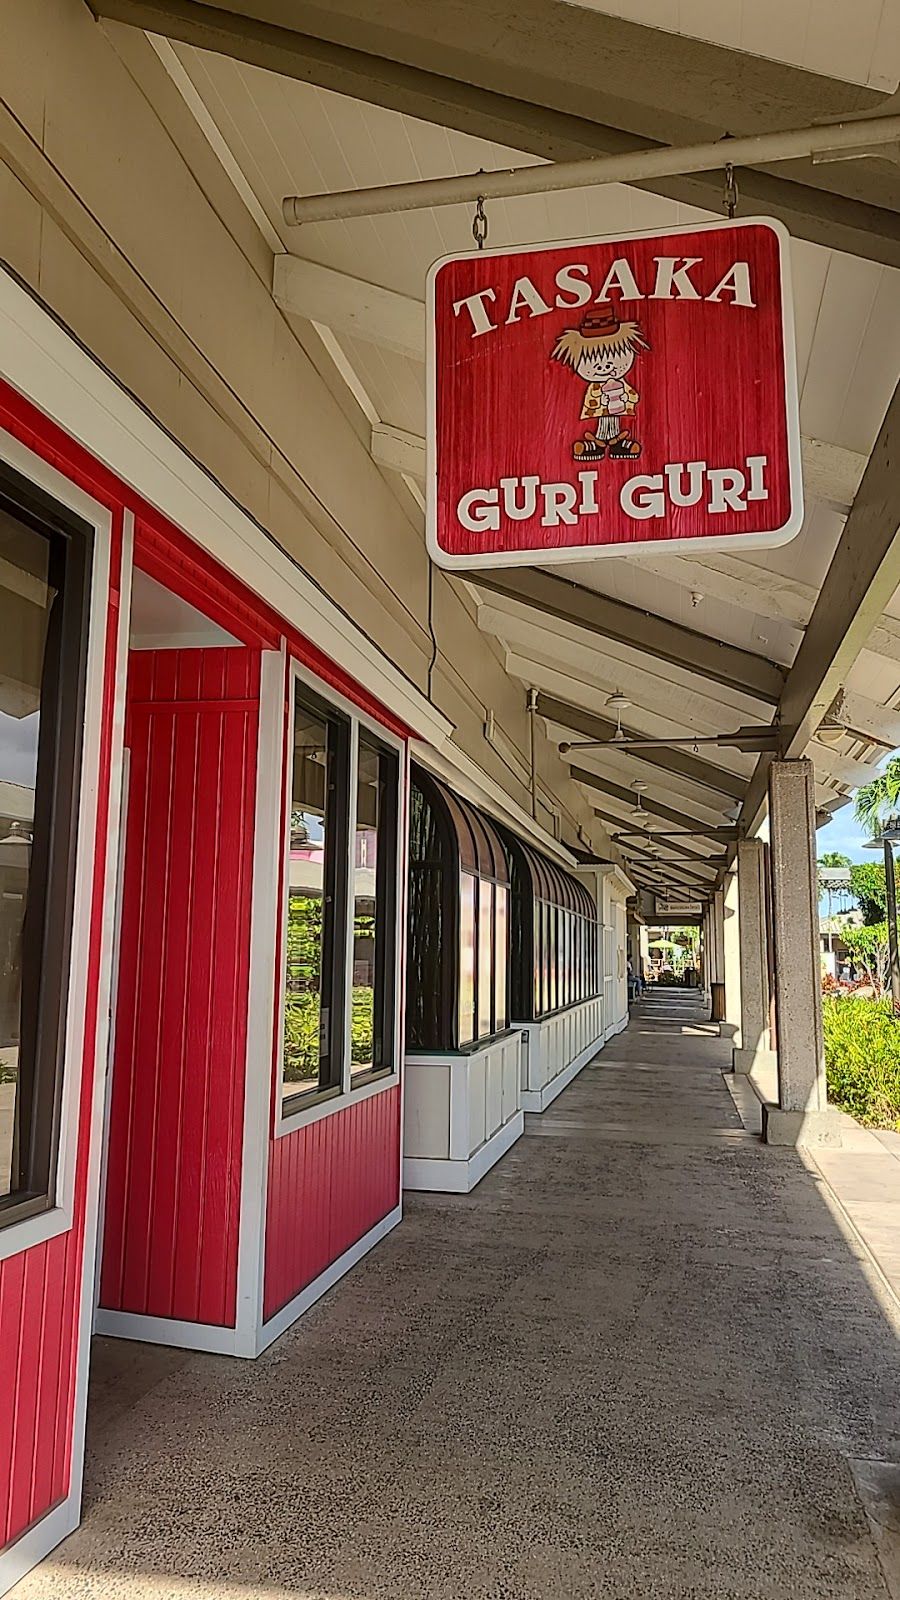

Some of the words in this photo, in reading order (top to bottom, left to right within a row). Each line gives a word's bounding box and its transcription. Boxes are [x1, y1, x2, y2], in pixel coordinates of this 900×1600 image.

[453, 257, 756, 338] TASAKA
[457, 471, 598, 532] GURI
[620, 456, 768, 519] GURI
